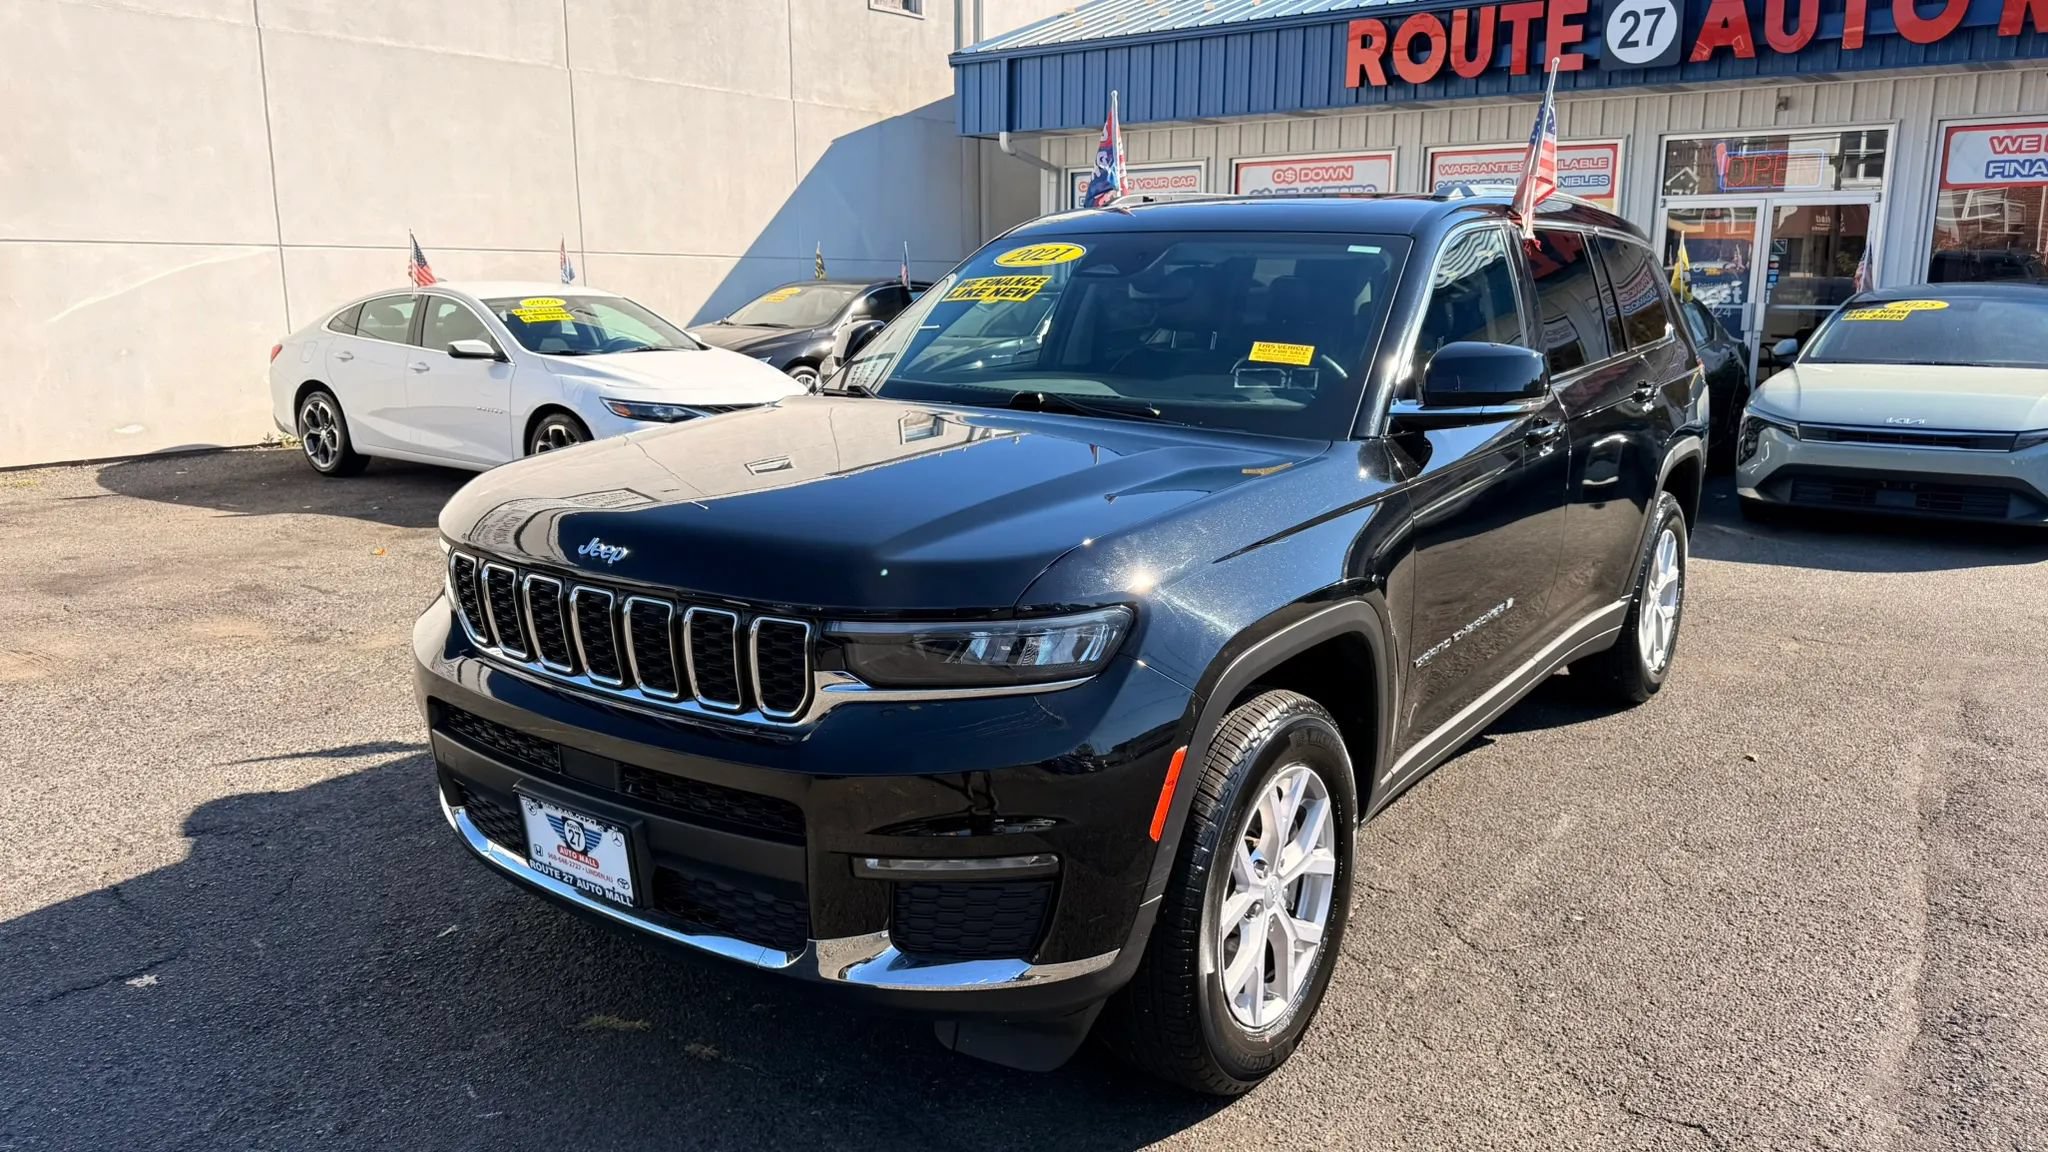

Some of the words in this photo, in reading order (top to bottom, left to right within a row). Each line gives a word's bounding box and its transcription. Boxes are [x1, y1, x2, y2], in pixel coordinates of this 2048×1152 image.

[1345, 0, 1588, 88] ROUTE
[1617, 7, 1666, 50] 27
[1688, 0, 1969, 63] AUTO
[1990, 134, 2042, 154] WE
[1299, 166, 1354, 182] DOWN
[1439, 161, 1524, 175] WARRANTIES
[1137, 177, 1169, 188] YOUR
[1171, 175, 1197, 187] CAR
[1004, 247, 1074, 263] 2021
[980, 277, 1048, 287] FINANCE
[952, 287, 988, 298] LIKE
[989, 287, 1035, 298] NEW
[578, 537, 629, 564] Jeep
[568, 829, 581, 848] 27
[559, 847, 578, 860] AUTO
[579, 855, 598, 868] MALL
[529, 859, 561, 879] ROUTE
[562, 872, 574, 885] 27
[576, 878, 603, 896] AUTO
[605, 888, 634, 908] MALL
